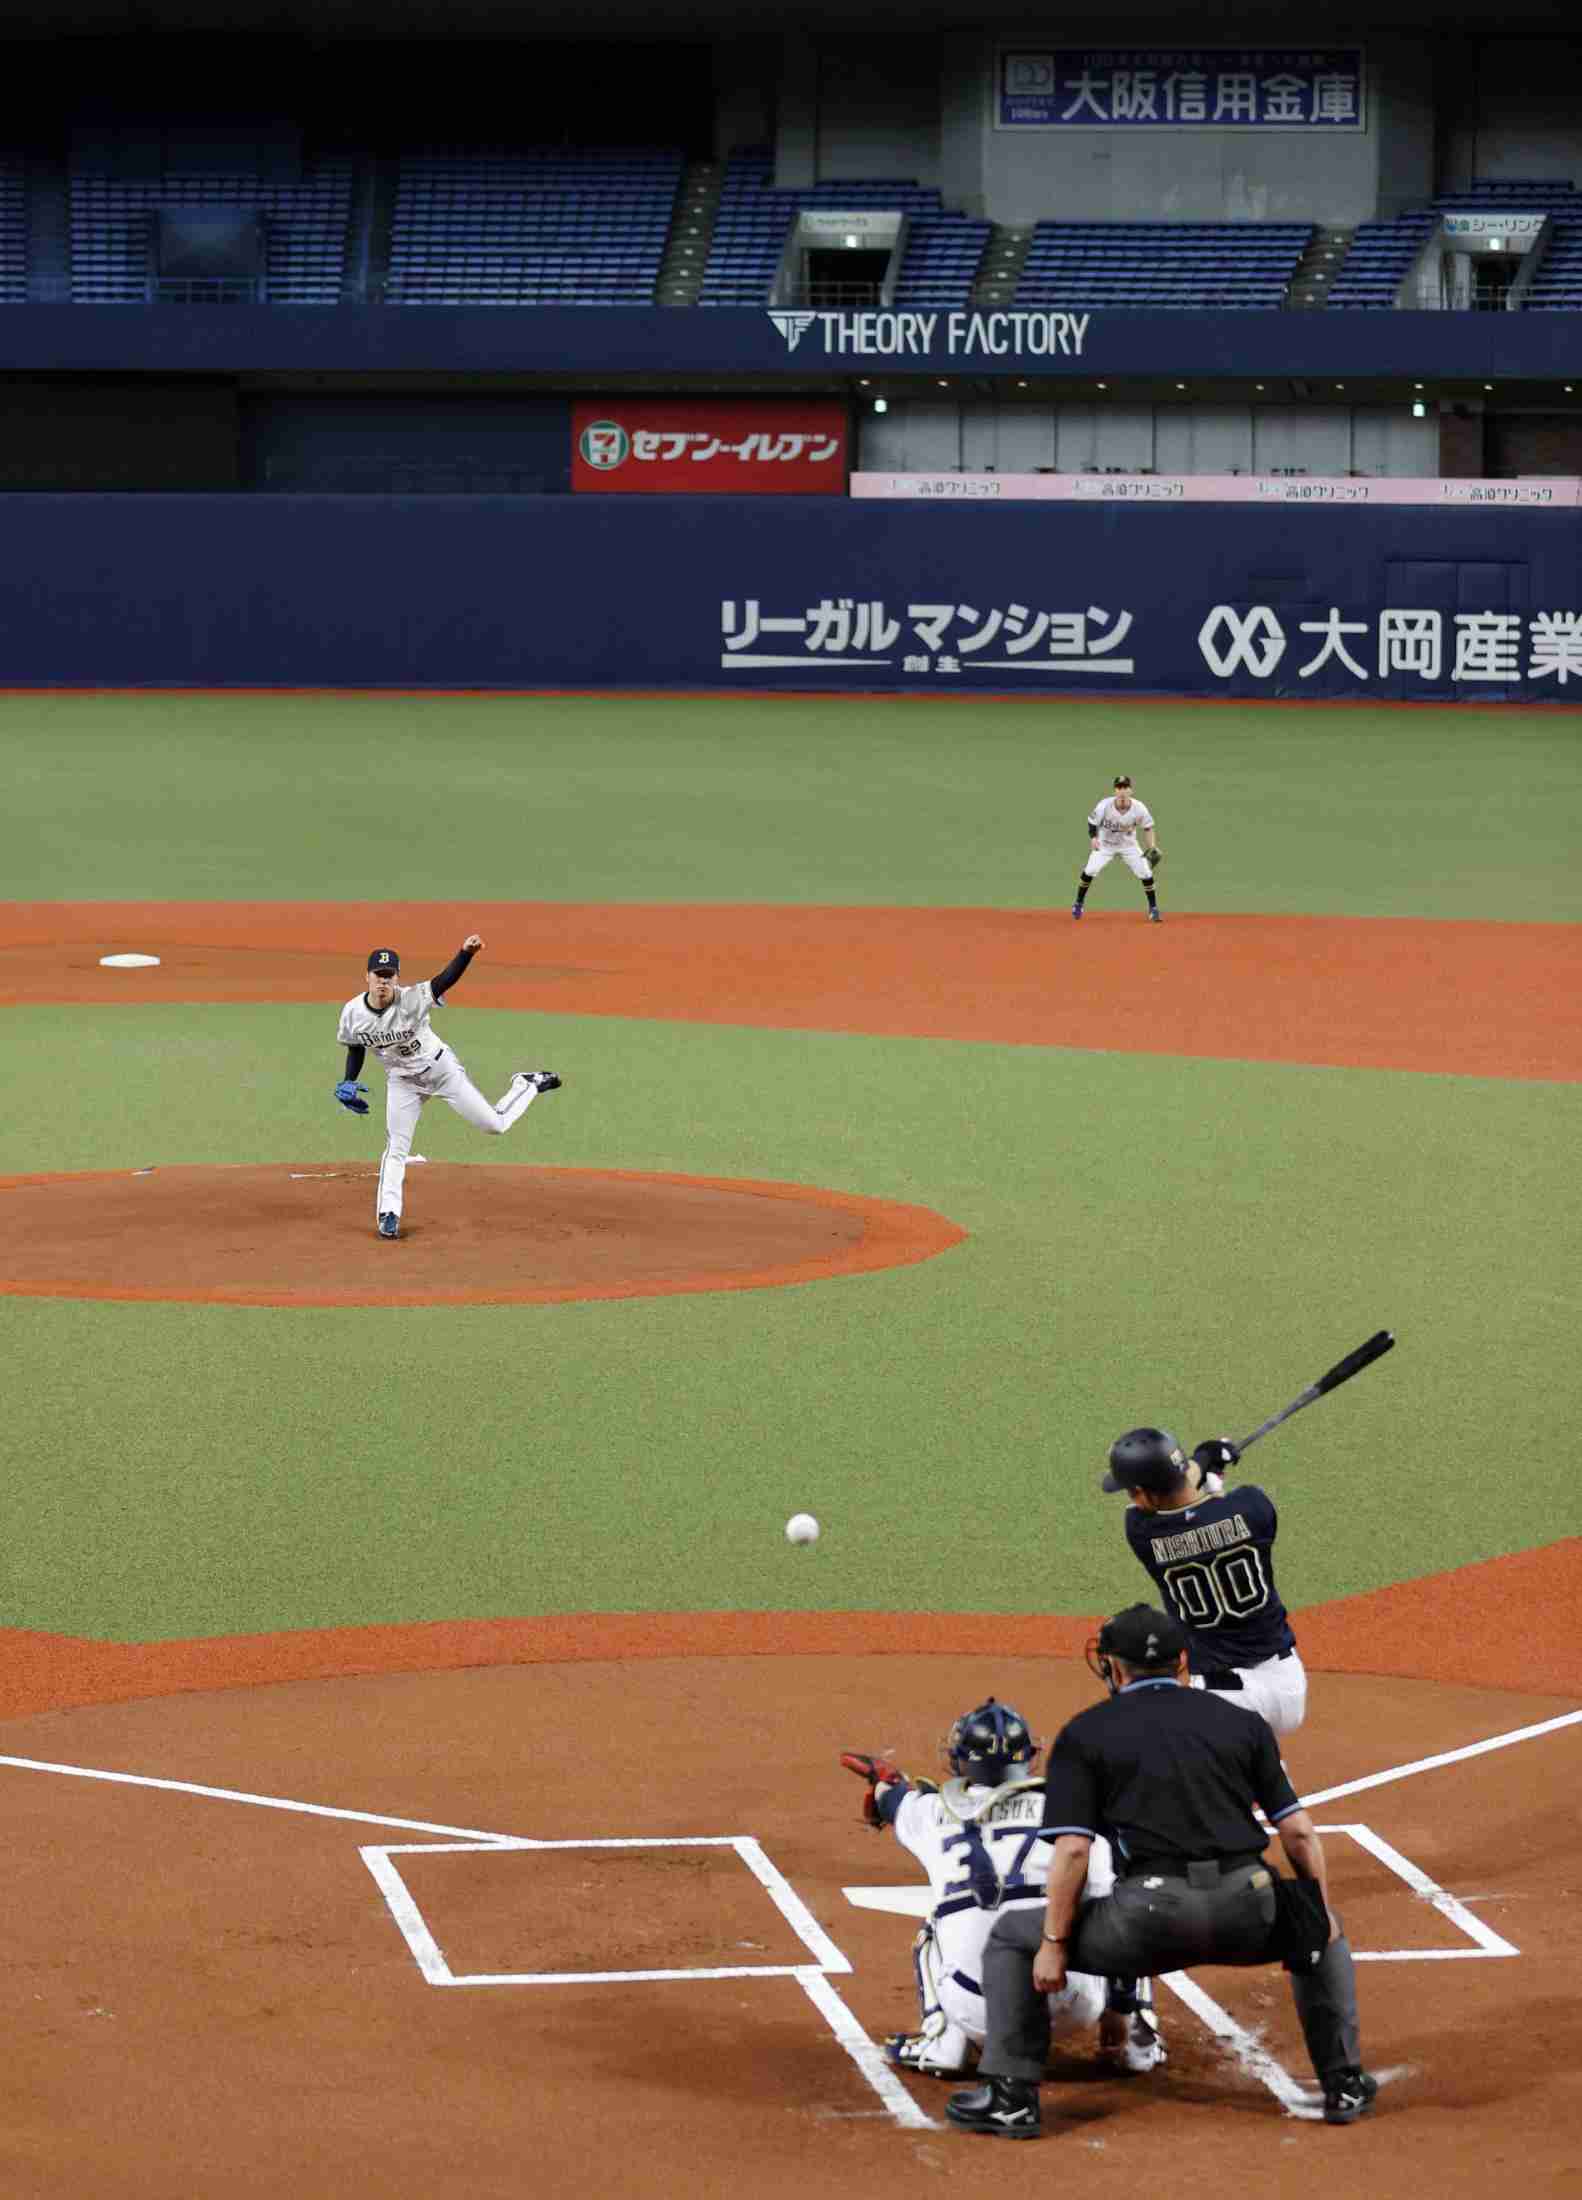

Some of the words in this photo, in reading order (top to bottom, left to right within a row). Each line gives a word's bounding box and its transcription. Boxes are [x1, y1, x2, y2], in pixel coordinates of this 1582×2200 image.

[1062, 71, 1356, 122] 大阪信用金庫
[817, 313, 937, 354] THEORY
[948, 313, 1089, 354] FACTORY
[1299, 607, 1582, 684] 大岡産業
[378, 952, 390, 963] B
[399, 1039, 422, 1057] 29
[1164, 1544, 1268, 1628] 00
[943, 1827, 1038, 1895] 37
